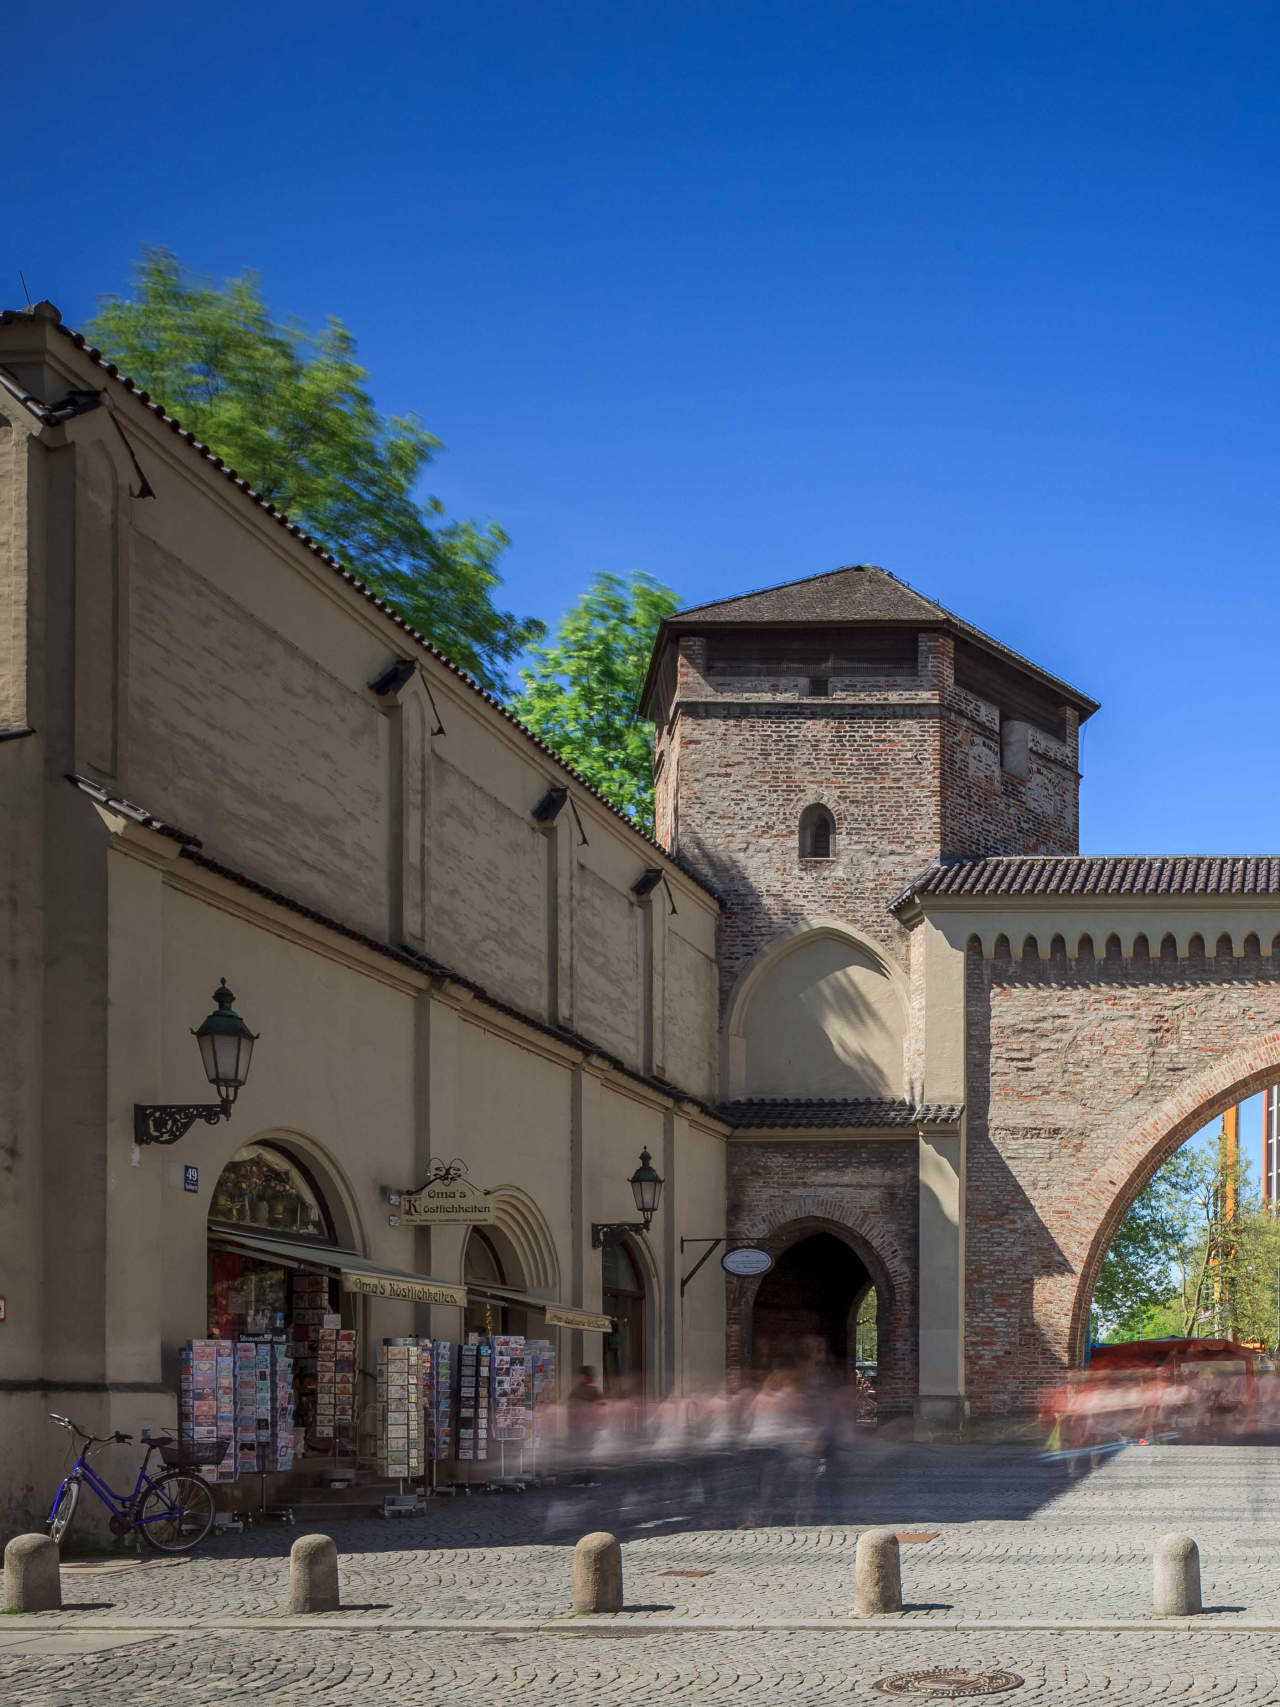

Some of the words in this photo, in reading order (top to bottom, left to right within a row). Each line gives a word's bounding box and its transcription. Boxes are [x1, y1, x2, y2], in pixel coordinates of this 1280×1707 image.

[186, 1168, 198, 1180] 49
[428, 1189, 466, 1199] Oma's
[355, 1278, 386, 1295] Oma's
[389, 1283, 457, 1304] Köstlichkeiten
